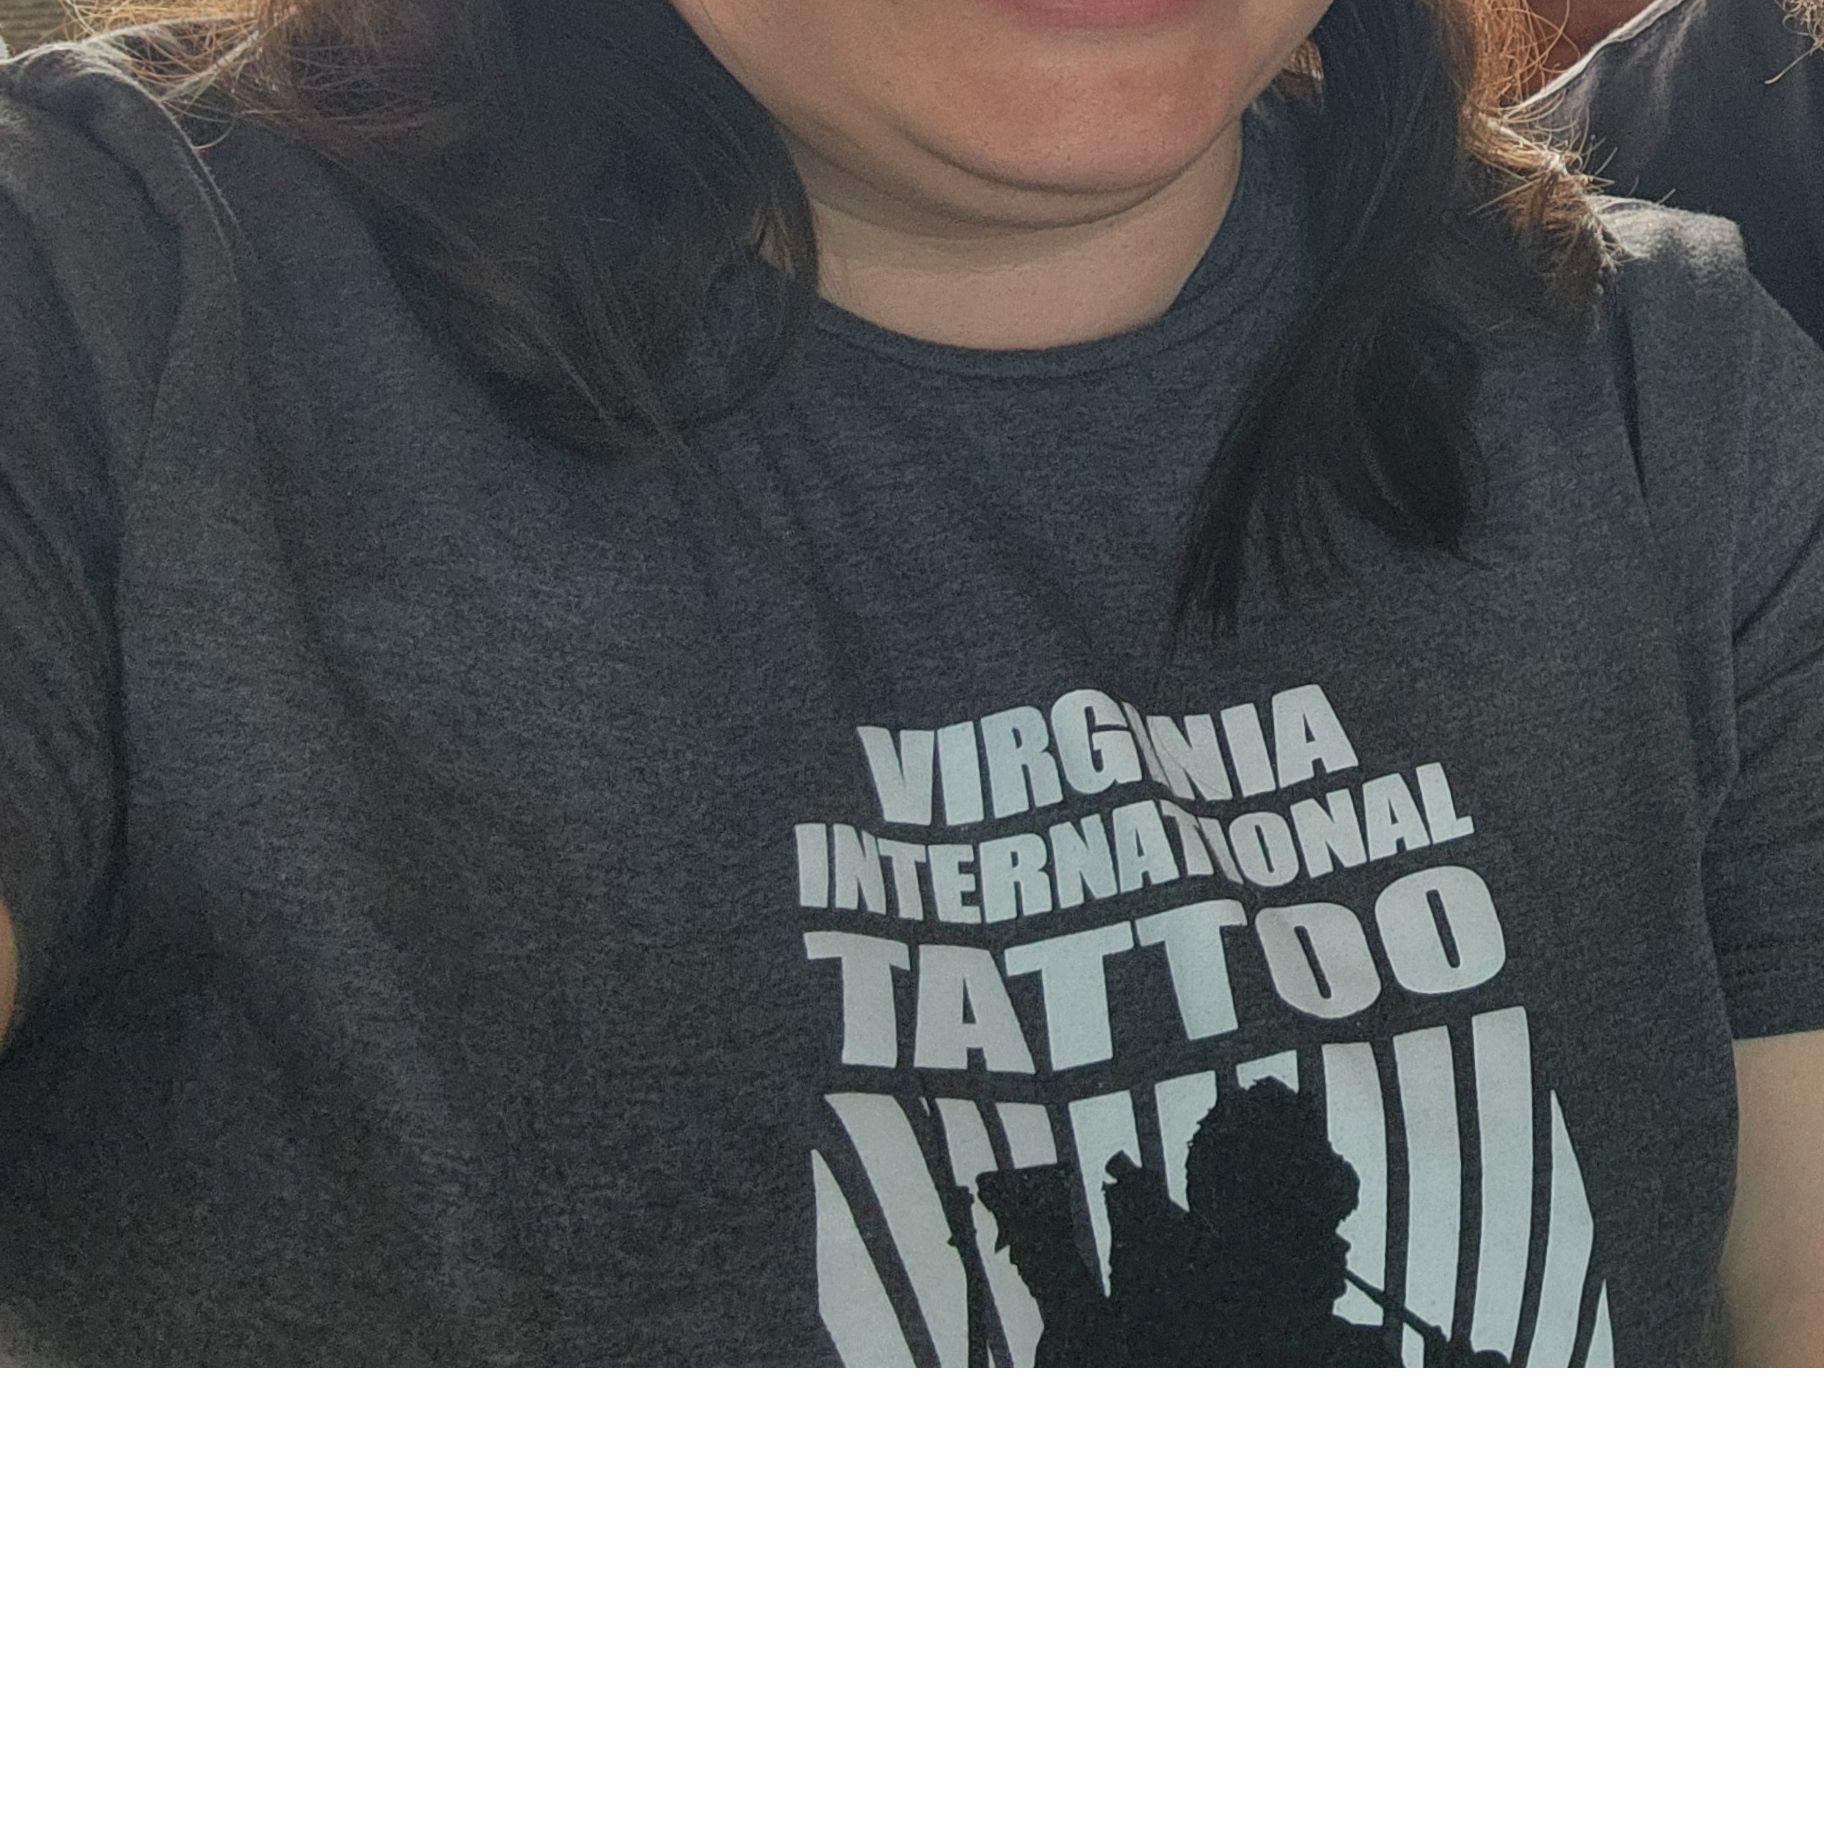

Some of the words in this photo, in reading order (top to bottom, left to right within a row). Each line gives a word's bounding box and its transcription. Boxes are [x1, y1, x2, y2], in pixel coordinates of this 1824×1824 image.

[856, 683, 1360, 826] VIRGINIA
[795, 762, 1475, 924] INTERNATIONAL
[803, 865, 1506, 1074] TATTOO
